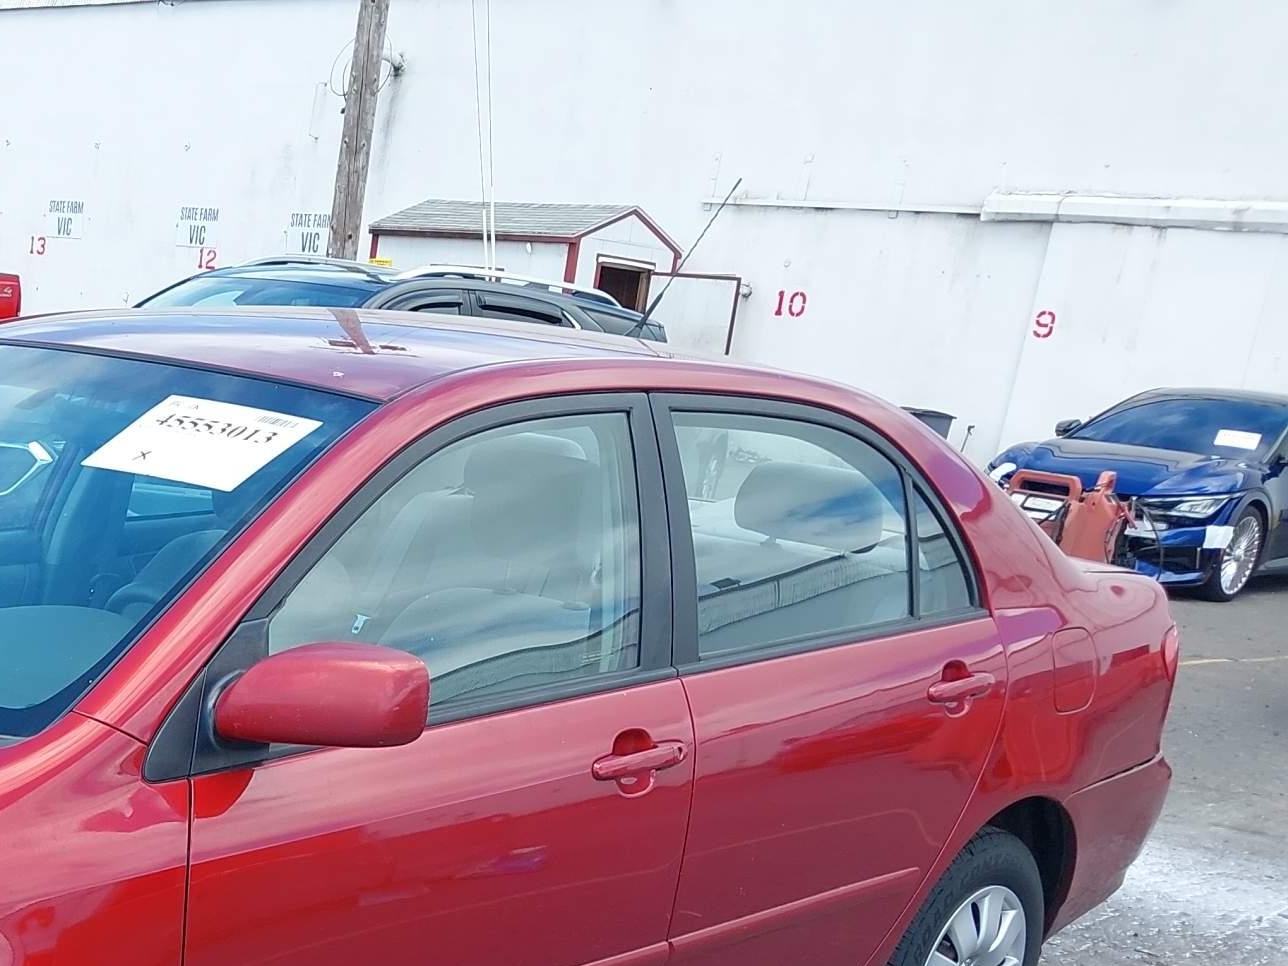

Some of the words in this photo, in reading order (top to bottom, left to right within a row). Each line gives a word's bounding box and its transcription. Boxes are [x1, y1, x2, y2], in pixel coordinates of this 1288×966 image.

[49, 200, 66, 213] STATE
[66, 201, 84, 214] FARM
[180, 207, 198, 221] STATE
[199, 208, 219, 222] FARM
[57, 217, 72, 236] VIC
[290, 213, 312, 228] STATE
[30, 235, 46, 255] 13
[189, 225, 206, 245] VIC
[301, 232, 320, 253] VIC
[198, 248, 217, 270] 12
[774, 290, 807, 318] 10
[1032, 310, 1056, 338] 9
[155, 413, 279, 444] 45553013
